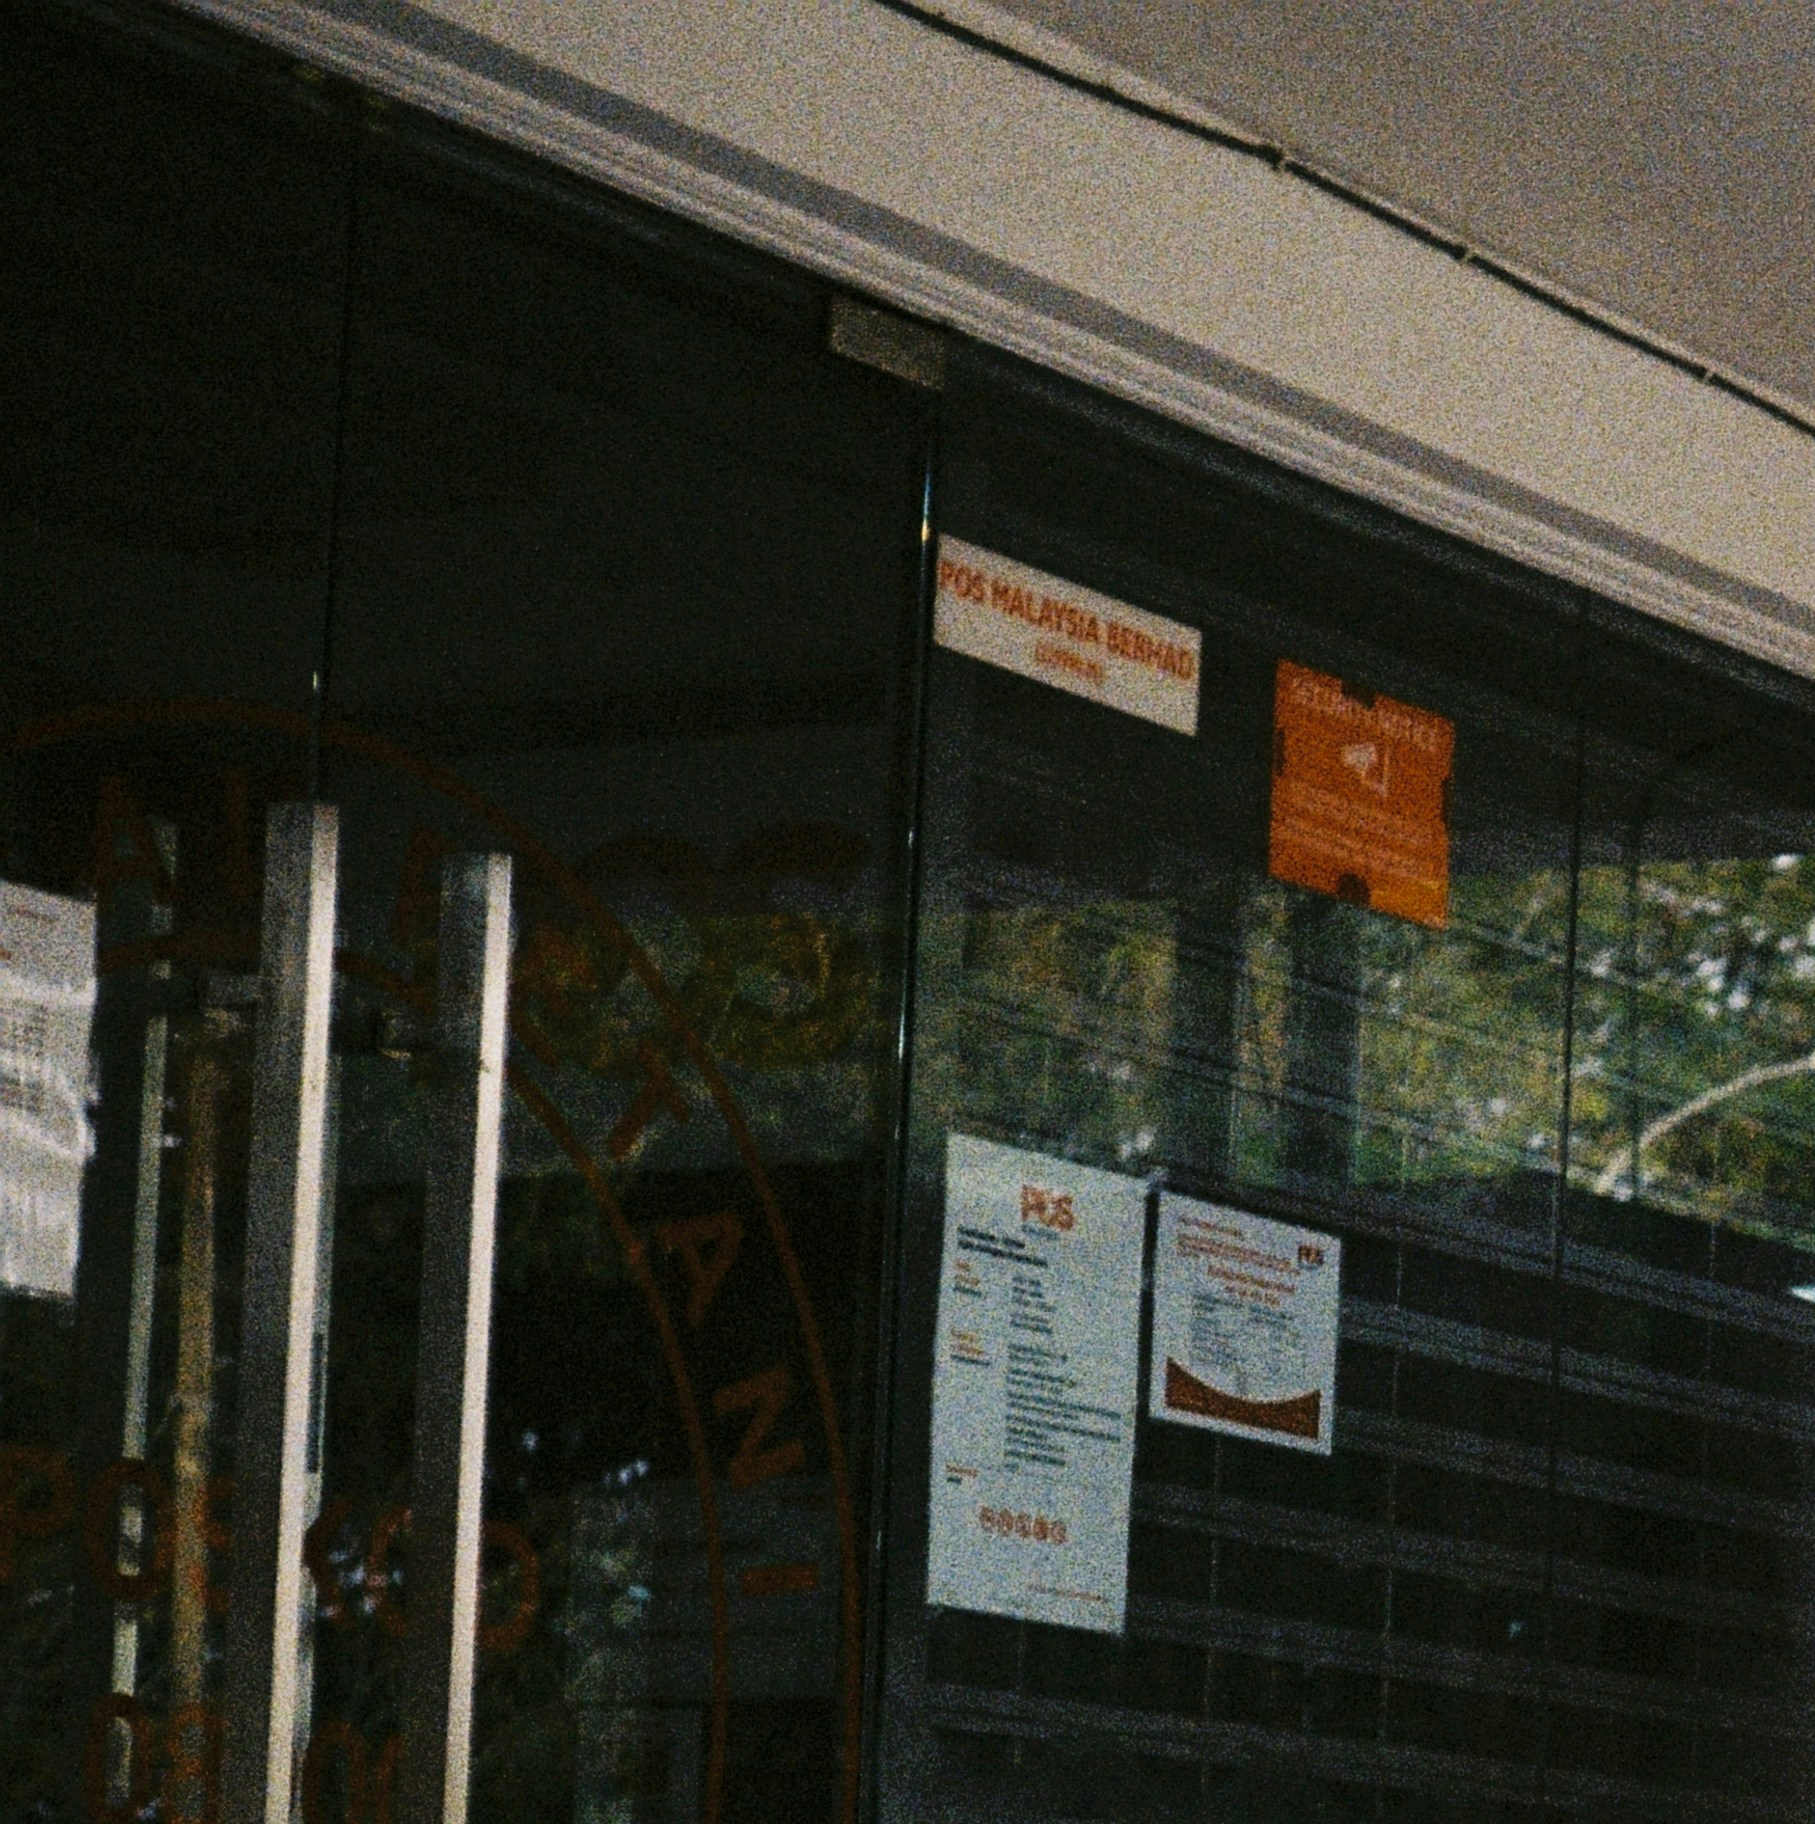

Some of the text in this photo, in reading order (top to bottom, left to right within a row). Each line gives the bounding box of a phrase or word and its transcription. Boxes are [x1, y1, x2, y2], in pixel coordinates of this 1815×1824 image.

[938, 558, 985, 604] POS
[990, 579, 1101, 644] MALAYSIA
[1106, 620, 1197, 681] BERHAD
